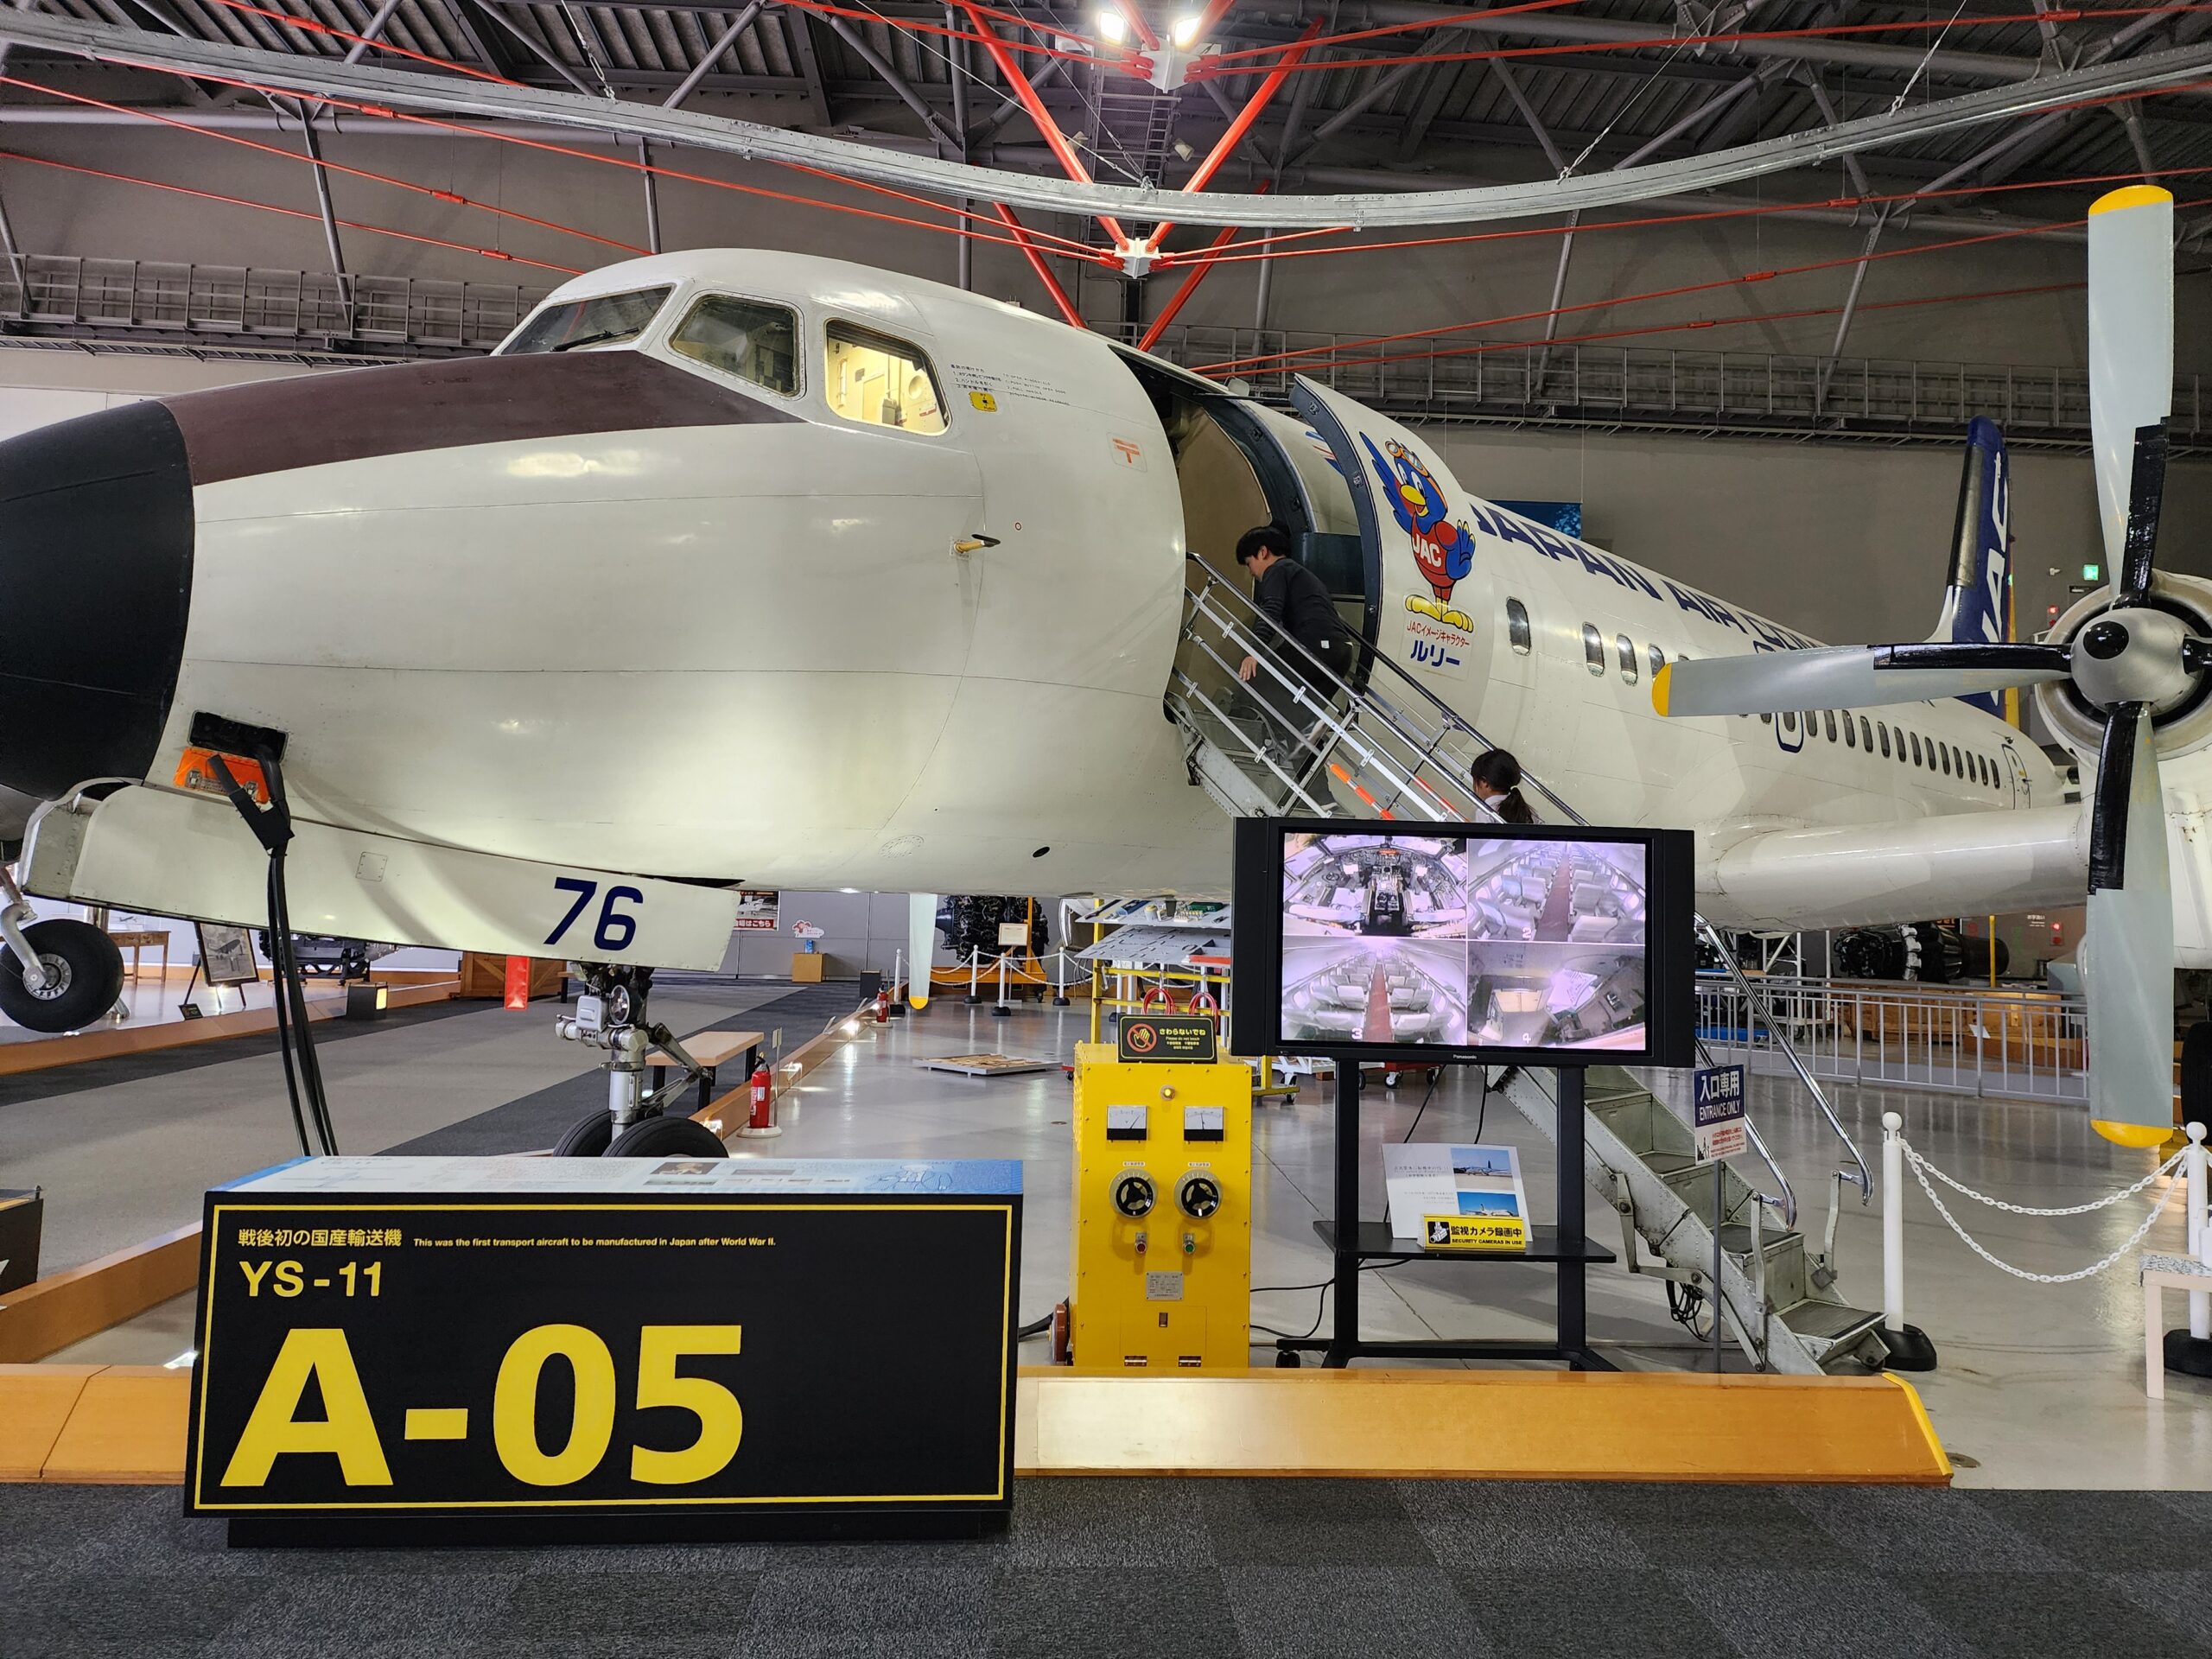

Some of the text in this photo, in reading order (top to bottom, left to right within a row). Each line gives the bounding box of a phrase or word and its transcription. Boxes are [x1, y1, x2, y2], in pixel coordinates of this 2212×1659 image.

[1413, 533, 1442, 568] JAC
[1470, 503, 1664, 602] JAPAN
[1659, 578, 1750, 635] AIR
[1407, 620, 1471, 648] JACイメージキャラクター
[1410, 639, 1461, 667] ルリー
[543, 877, 644, 950] 76
[1522, 927, 1532, 939] 2
[1351, 1027, 1363, 1040] 3
[1522, 1033, 1532, 1044] 4
[1700, 1071, 1740, 1103] 入口専用
[1700, 1099, 1741, 1122] ENTRANCE ONLY
[238, 1228, 403, 1247] 戦後初の国産輸送機
[414, 1238, 432, 1247] This
[455, 1238, 471, 1247] the
[473, 1238, 491, 1247] first
[493, 1238, 535, 1248] transport
[536, 1237, 569, 1246] aircraft
[582, 1237, 594, 1246] be
[596, 1237, 658, 1246] manufactured
[658, 1237, 668, 1246] in
[670, 1237, 696, 1248] Japan
[698, 1237, 720, 1246] after
[721, 1237, 747, 1246] World
[748, 1237, 766, 1246] War
[1450, 1225, 1522, 1237] 監視カメラ録画中
[220, 1323, 744, 1487] A-05
